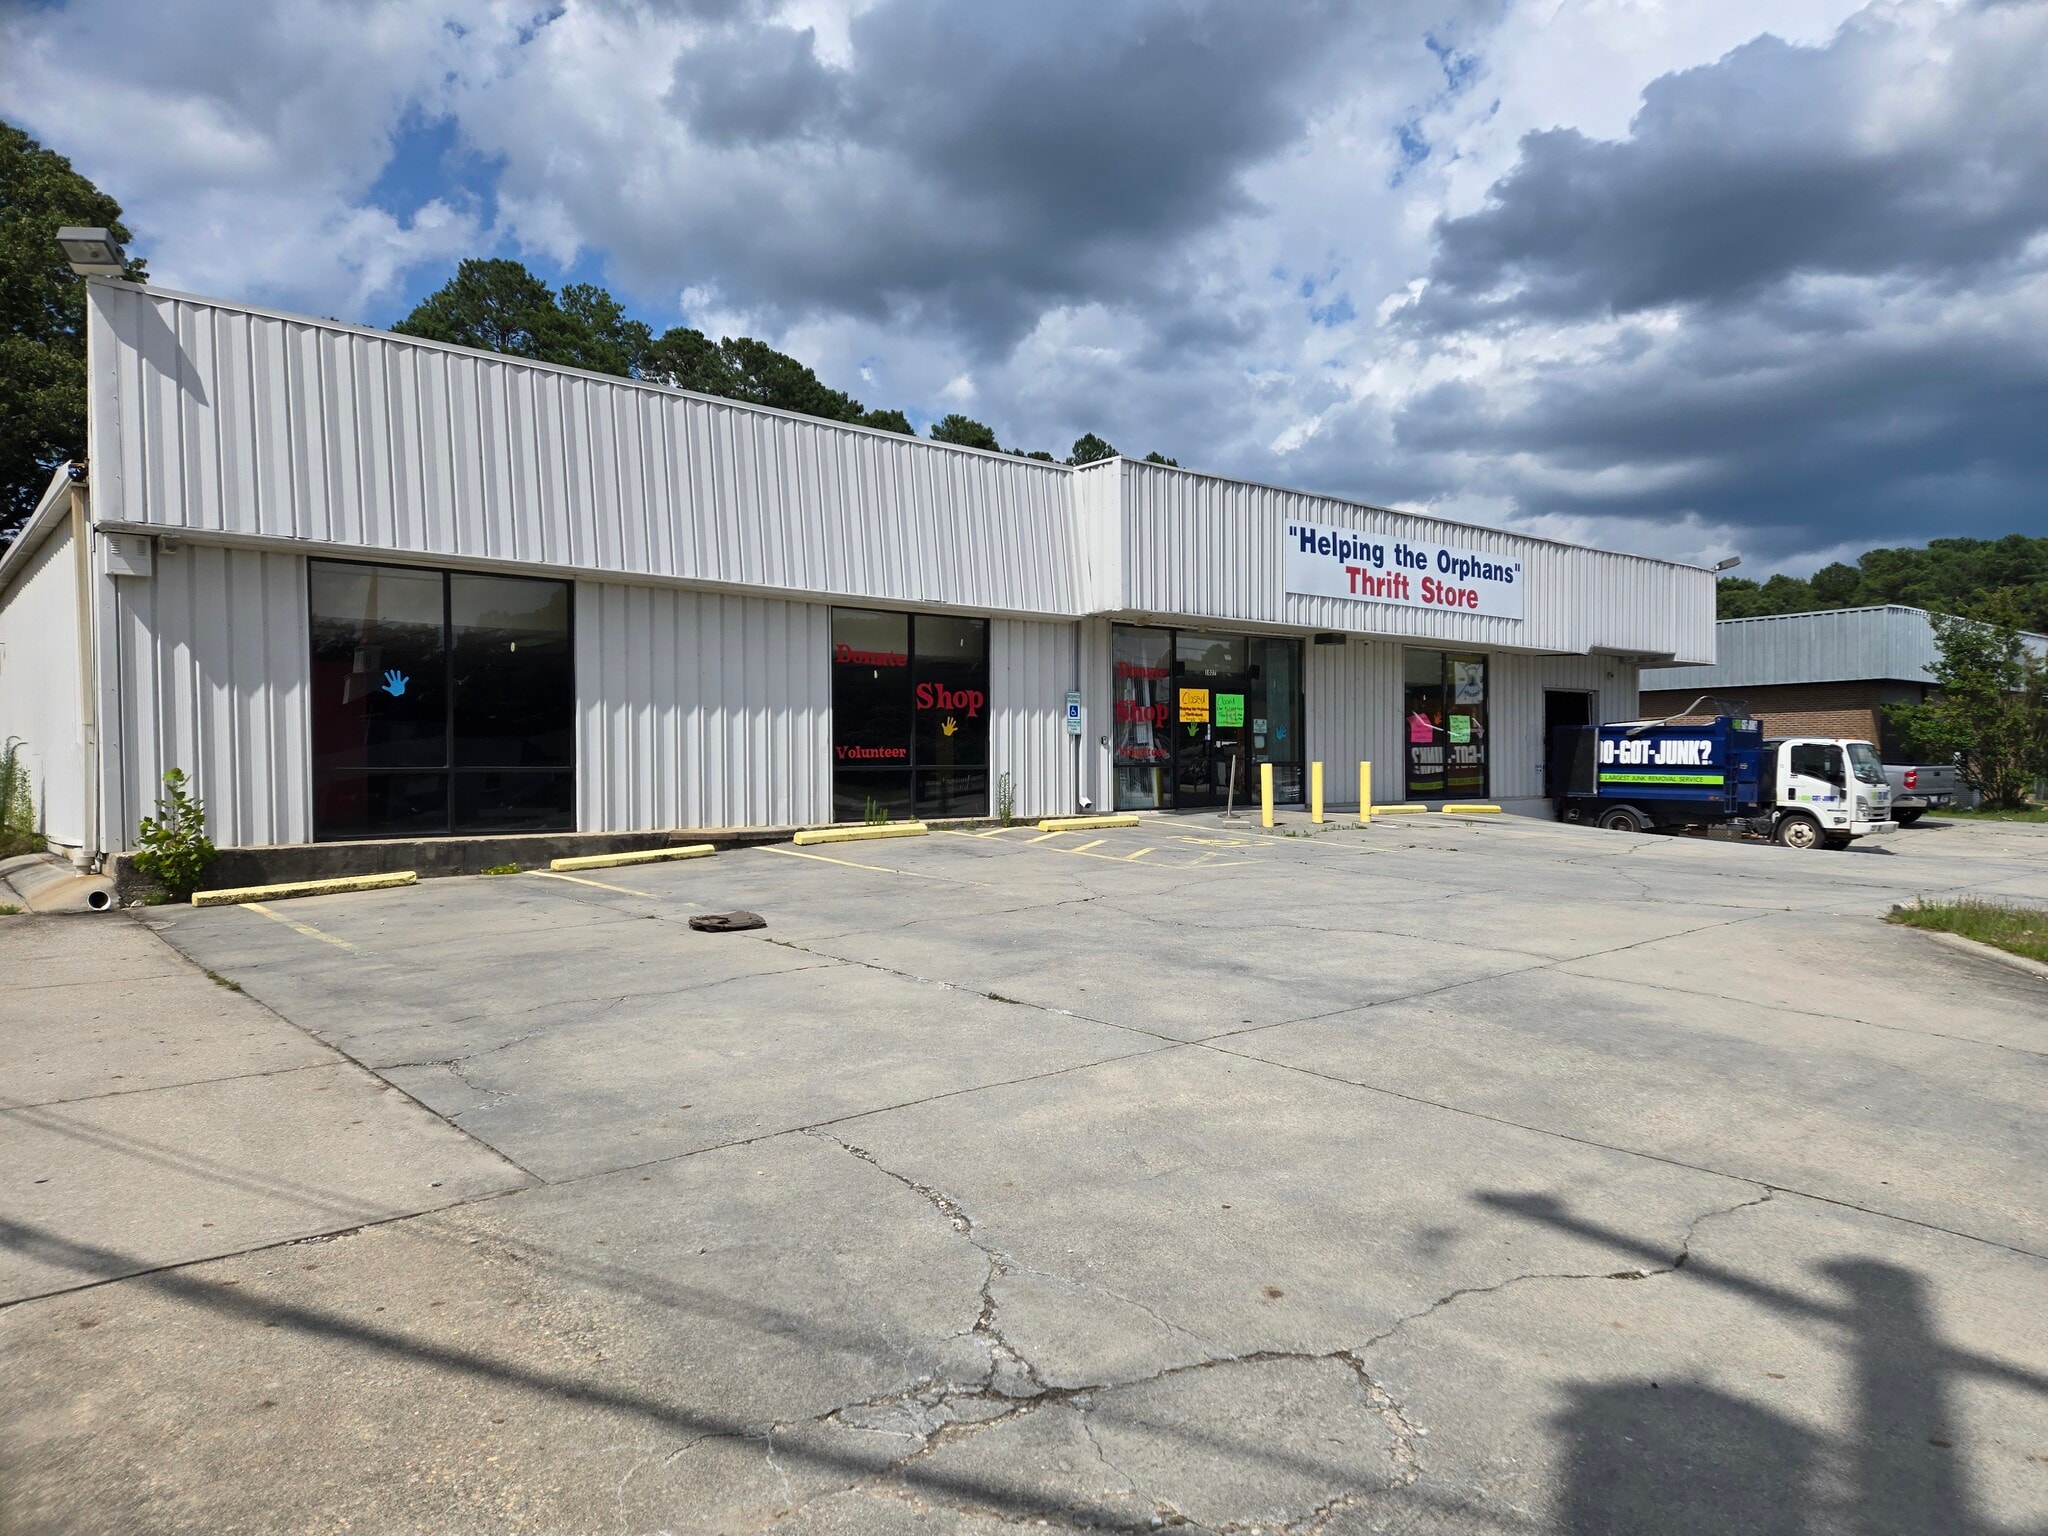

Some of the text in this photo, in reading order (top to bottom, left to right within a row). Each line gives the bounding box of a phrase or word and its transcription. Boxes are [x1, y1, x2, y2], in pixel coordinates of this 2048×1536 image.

[1289, 526, 1521, 584] "Helping the Orphans"
[1345, 566, 1479, 609] Thrift Store
[836, 644, 908, 667] Donate
[916, 682, 984, 717] Shop
[1116, 699, 1168, 728] Shop
[836, 746, 907, 759] Volunteer
